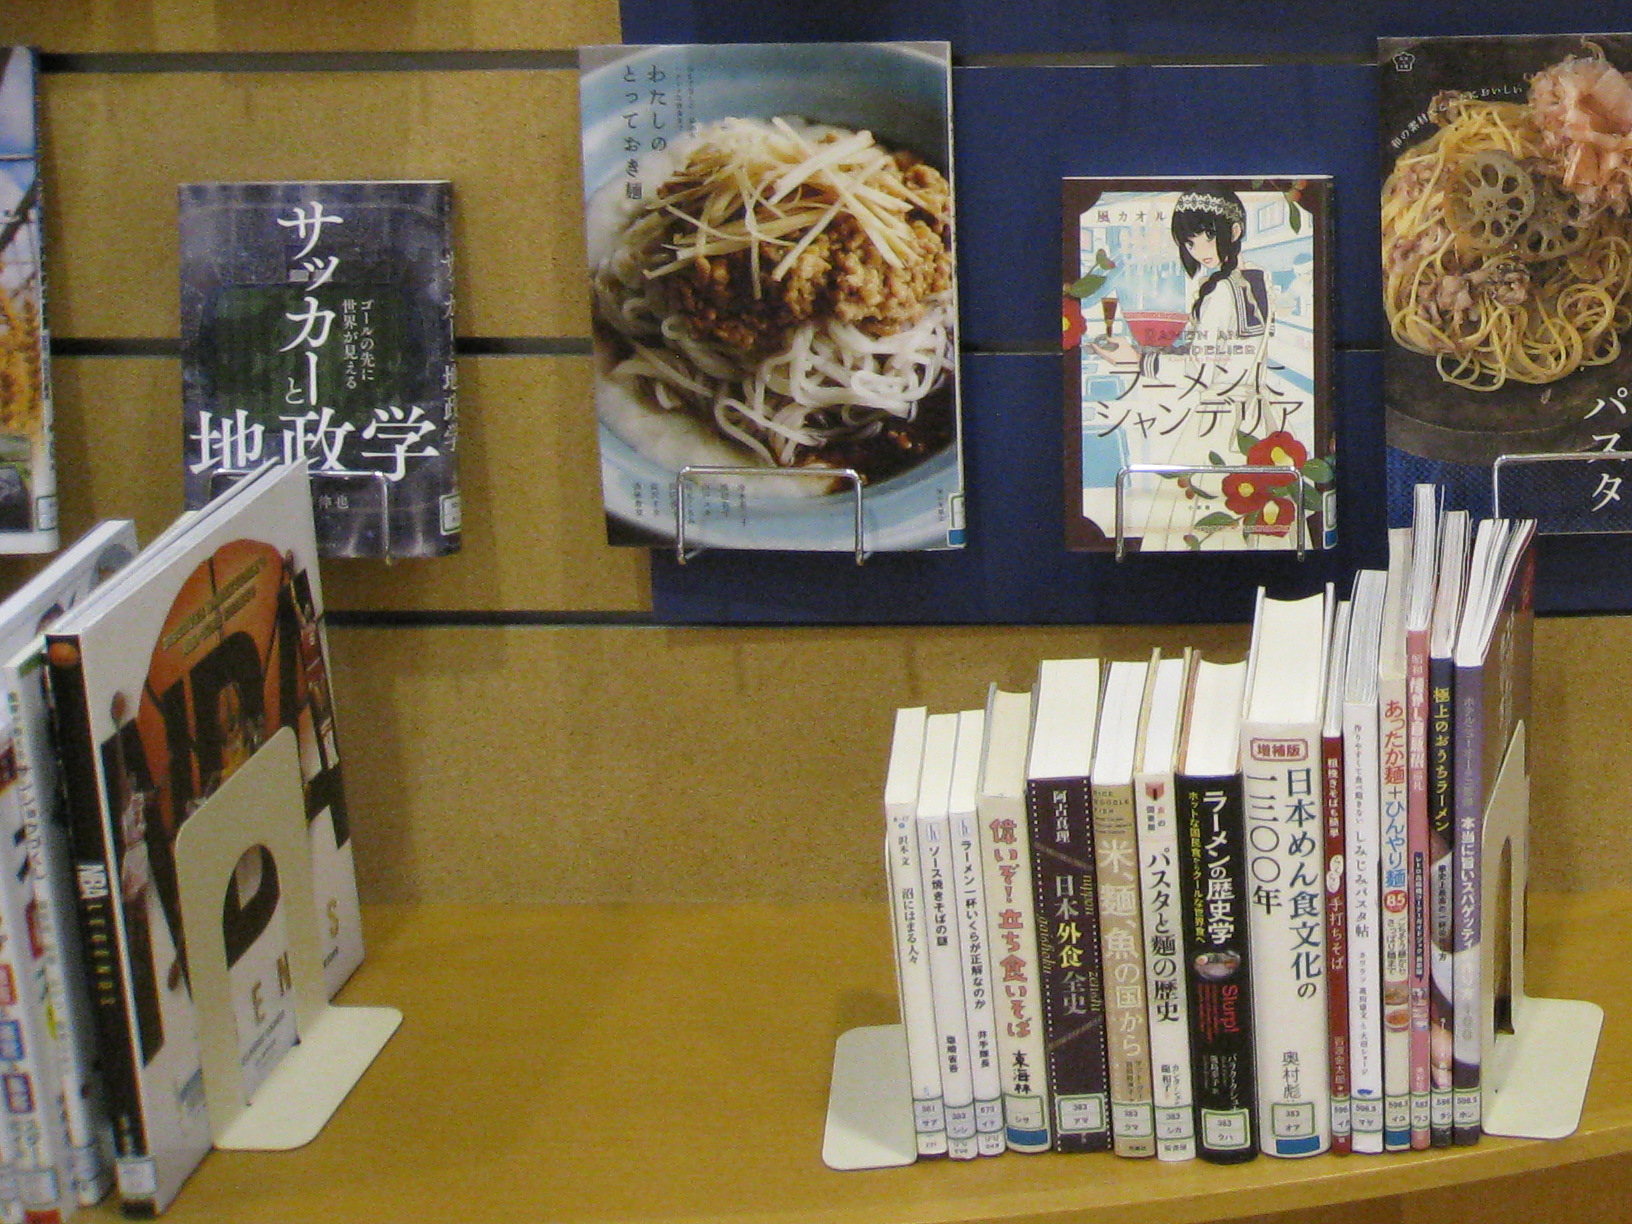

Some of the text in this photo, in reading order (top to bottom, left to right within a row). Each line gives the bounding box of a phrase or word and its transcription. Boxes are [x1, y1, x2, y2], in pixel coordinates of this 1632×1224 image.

[647, 64, 667, 151] わたしの
[1096, 209, 1168, 223] 風カオル
[278, 201, 344, 406] サッカーと
[343, 299, 358, 389] 世界が見える
[360, 299, 376, 381] ゴールの先に
[1097, 397, 1304, 438] シャンデリア
[1109, 362, 1286, 400] ラーメンに
[189, 405, 440, 482] 地政学
[1584, 387, 1628, 511] パスタ
[1257, 742, 1302, 759] 増補版
[1433, 687, 1450, 832] 極上のおうちラーメン
[77, 862, 109, 899] NBA
[1203, 791, 1235, 945] ラーメンの歴史学
[1285, 768, 1323, 999] 日本めん食文化の
[1355, 831, 1369, 938] しみじみパスタ帖
[1387, 894, 1406, 908] 85
[961, 841, 985, 1009] ラーメン一杯いくらが正解なのか
[1053, 875, 1089, 1016] 日本外食全史
[1147, 847, 1180, 1023] パスタと麺の歴史
[1329, 898, 1345, 970] 手打ちそば
[1222, 983, 1239, 1034] Slurp!
[1282, 1051, 1300, 1102] 奥村彪
